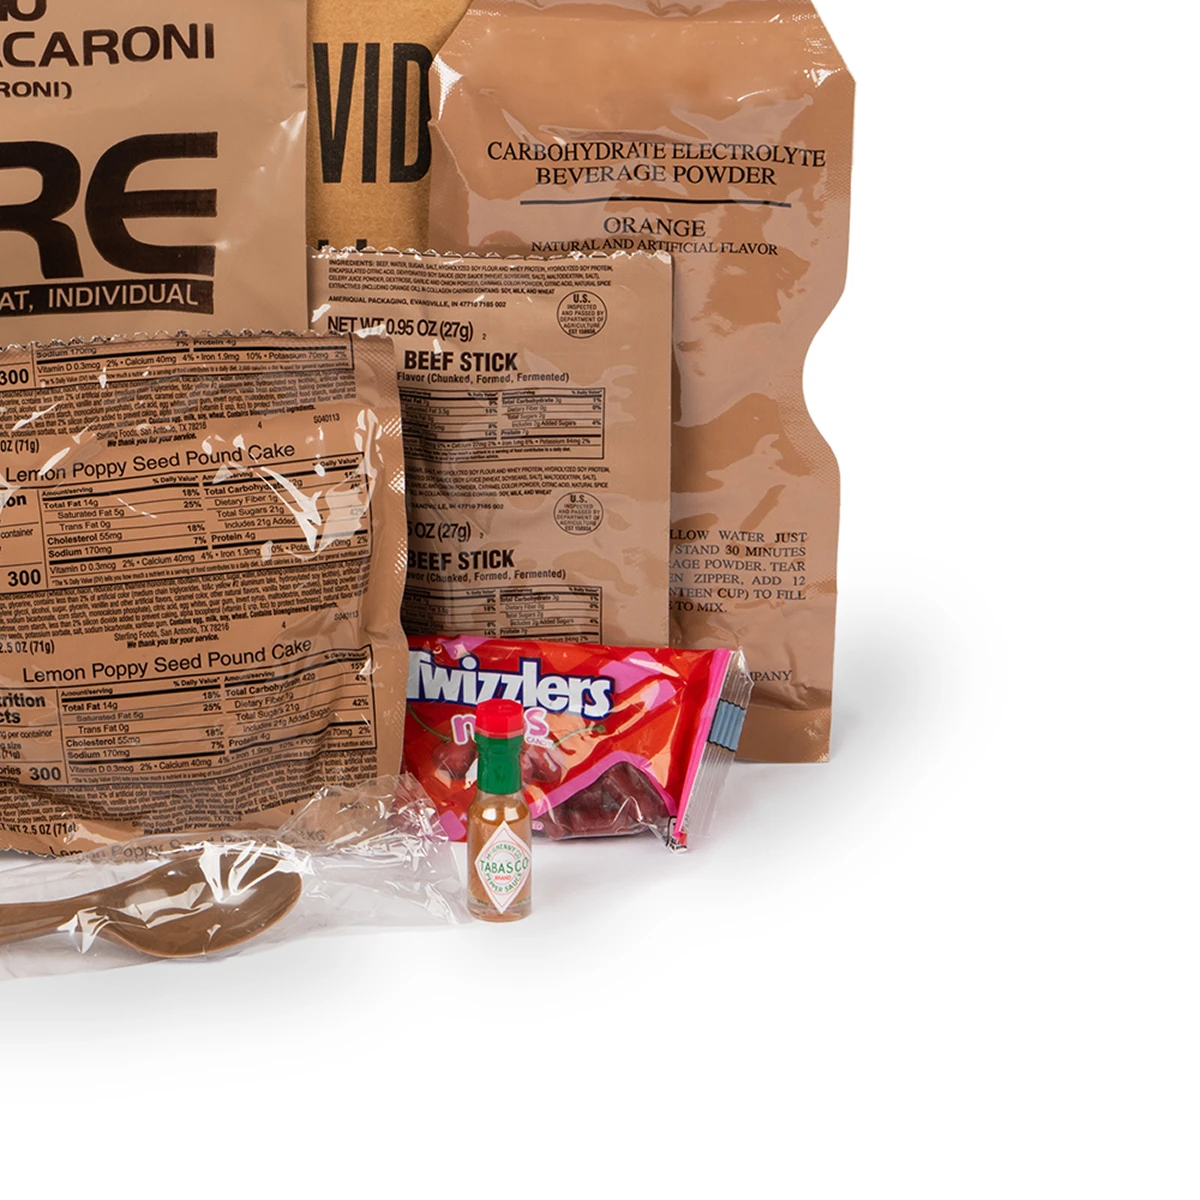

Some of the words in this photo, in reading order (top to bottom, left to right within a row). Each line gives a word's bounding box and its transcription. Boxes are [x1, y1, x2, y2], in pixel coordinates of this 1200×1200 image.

[487, 140, 666, 162] CARBOHYDRATE
[672, 142, 826, 168] ELECTROLYTE
[535, 163, 667, 186] BEVERAGE
[672, 164, 778, 186] POWDER
[603, 216, 707, 238] ORANGE
[531, 240, 601, 254] NATURAL
[602, 238, 636, 252] AND
[637, 240, 719, 254] ARTIFICIAL
[720, 241, 779, 256] FLAVOR
[47, 281, 200, 310] INDIVIDUAL
[572, 293, 592, 304] U.S.
[327, 315, 357, 334] NET
[385, 318, 415, 337] 0.95
[416, 318, 438, 337] OZ
[439, 319, 474, 343] (27g)
[403, 349, 454, 372] BEEF
[459, 350, 519, 373] STICK
[426, 371, 472, 385] (Chunked,
[475, 372, 515, 385] Formed,
[515, 370, 570, 384] Fermented)
[5, 465, 66, 484] Lemon
[72, 461, 128, 481] Poppy
[133, 453, 181, 472] Seed
[186, 447, 243, 467] Pound
[248, 443, 296, 461] Cake
[416, 521, 436, 539] OZ
[437, 521, 471, 544] (27g)
[718, 530, 766, 543] WATER
[774, 531, 808, 543] JUST
[408, 552, 452, 572] BEEF
[457, 549, 516, 571] STICK
[674, 544, 720, 556] STAND
[725, 545, 740, 556] 30
[745, 545, 807, 557] MINUTES
[704, 560, 767, 572] POWDER.
[769, 561, 806, 572] TEAR
[7, 568, 42, 587] 300
[693, 573, 745, 586] ZIPPER,
[751, 575, 782, 586] ADD
[792, 576, 806, 587] 12
[717, 588, 750, 601] CUP)
[753, 589, 773, 600] TO
[776, 589, 807, 601] FILL
[676, 600, 694, 611] TO
[696, 602, 728, 613] MIX.
[22, 666, 86, 683] Lemon
[91, 661, 149, 684] Poppy
[154, 653, 201, 673] Seed
[208, 649, 266, 668] Pound
[271, 638, 313, 660] Cake
[406, 654, 606, 717] Twizzlers
[480, 856, 530, 874] TABASCO
